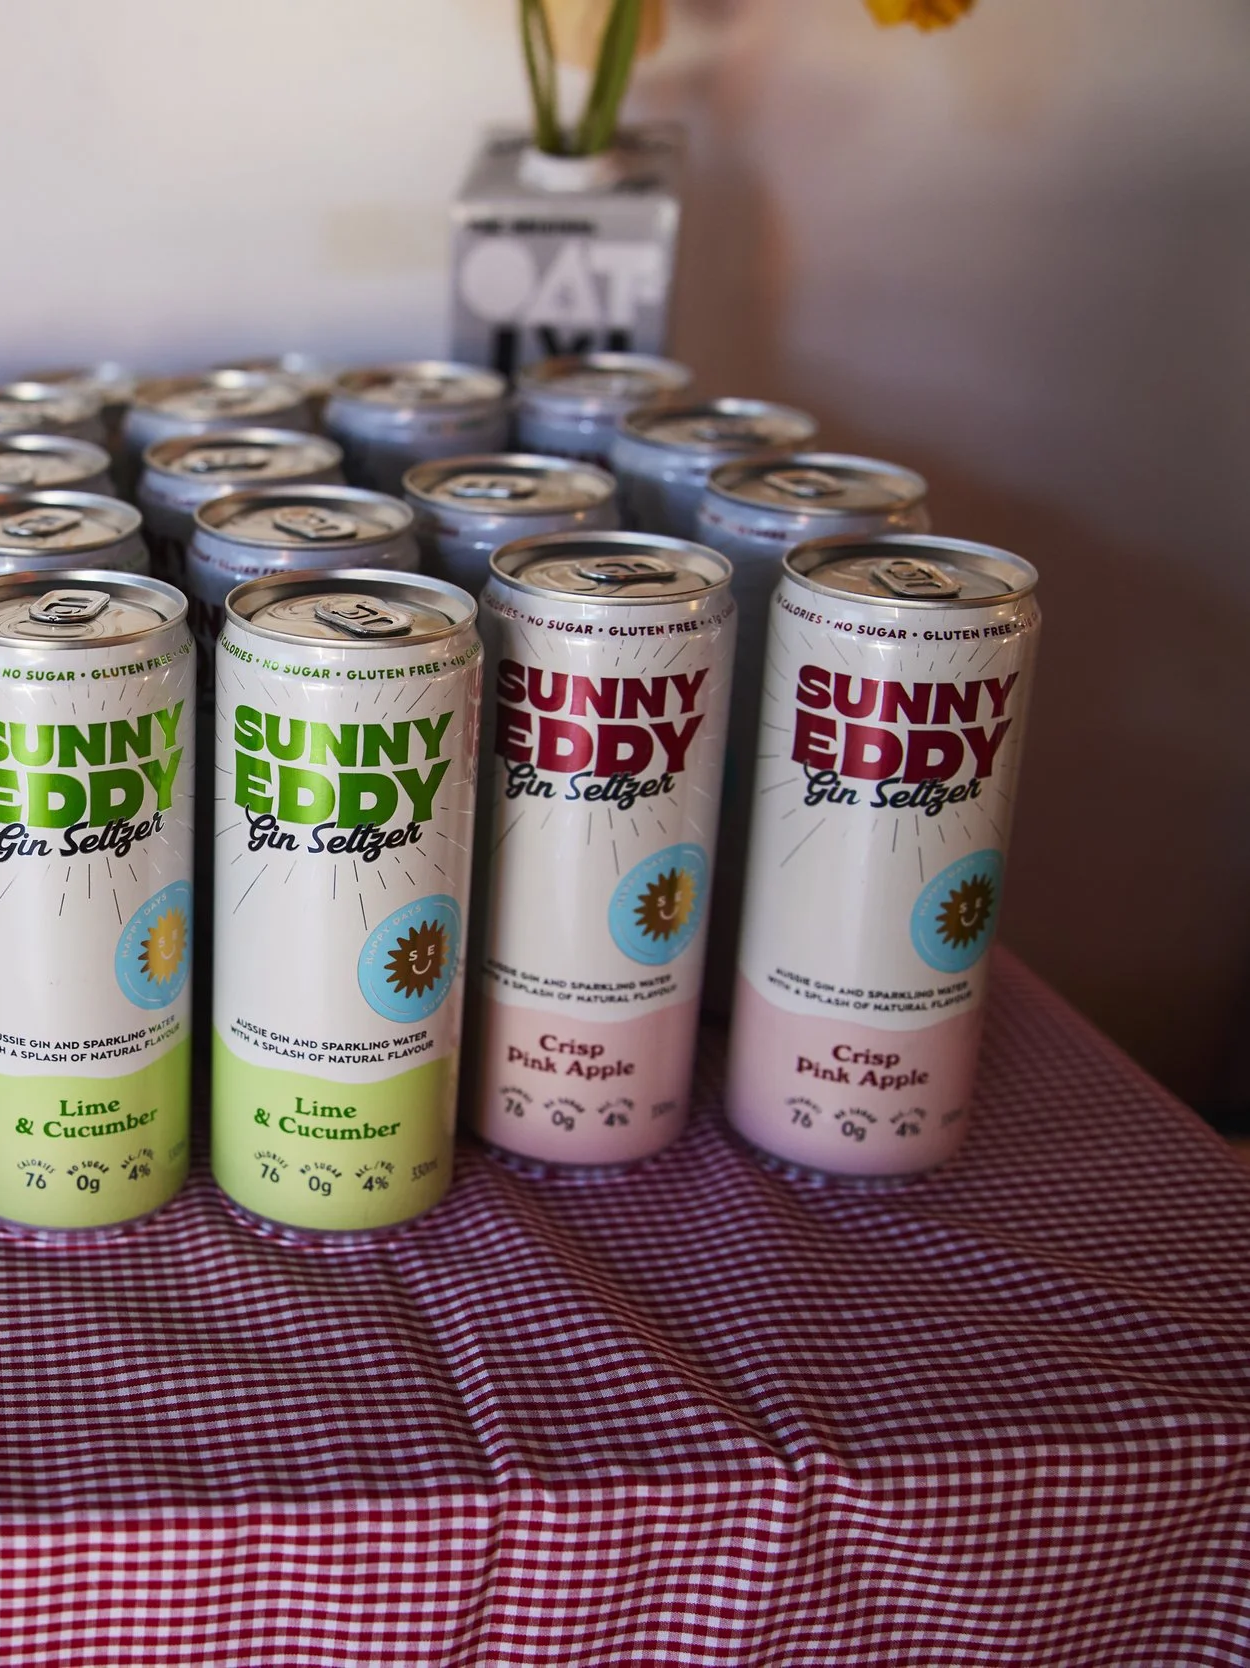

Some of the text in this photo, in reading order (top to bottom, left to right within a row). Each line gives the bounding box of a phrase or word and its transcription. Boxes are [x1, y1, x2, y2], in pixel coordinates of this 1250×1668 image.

[527, 616, 698, 636] NO SUGAR GLUTEN FREE
[781, 599, 1012, 641] CALORIES NO SUGAR GLUTEN FREE
[2, 669, 21, 680] NO
[26, 670, 75, 681] SUGAR
[91, 662, 145, 680] GLUTEN
[147, 653, 173, 670] FREE
[220, 637, 440, 680] CALORIES NO SUGAR GLUTEN FREE
[497, 659, 709, 719] SUNNY
[796, 665, 1020, 724] SUNNY
[234, 704, 454, 767] SUNNY
[495, 703, 705, 778] EDDY
[791, 708, 1013, 784] EDDY
[234, 749, 452, 829] EDDY
[505, 755, 675, 811] Gin Seltzer
[802, 760, 983, 817] Gin Seltzer
[59, 812, 165, 858] Seltzer
[245, 804, 423, 863] Gin Seltzer
[10, 1050, 18, 1058] A
[21, 1050, 67, 1062] SPLASH
[71, 1051, 88, 1062] OF
[90, 1043, 142, 1061] NATURAL
[144, 1022, 180, 1049] FLAVOUR
[30, 1039, 51, 1049] GIN
[54, 1040, 80, 1050] AND
[83, 1029, 146, 1049] SPARKLING
[148, 1014, 175, 1036] WATER
[539, 1034, 606, 1059] Crisp
[507, 1045, 636, 1081] Pink Apple
[796, 1055, 930, 1091] Pink Apple
[831, 1044, 901, 1068] Crisp
[15, 1107, 158, 1139] & Cucumber
[59, 1099, 121, 1117] Lime
[254, 1107, 401, 1140] & Cucumber
[295, 1097, 357, 1119] Lime
[25, 1172, 47, 1189] 76
[76, 1175, 100, 1194] 0g
[128, 1163, 151, 1181] 4%
[260, 1164, 280, 1183] 76
[308, 1175, 332, 1196] 0g
[362, 1175, 389, 1192] 4%
